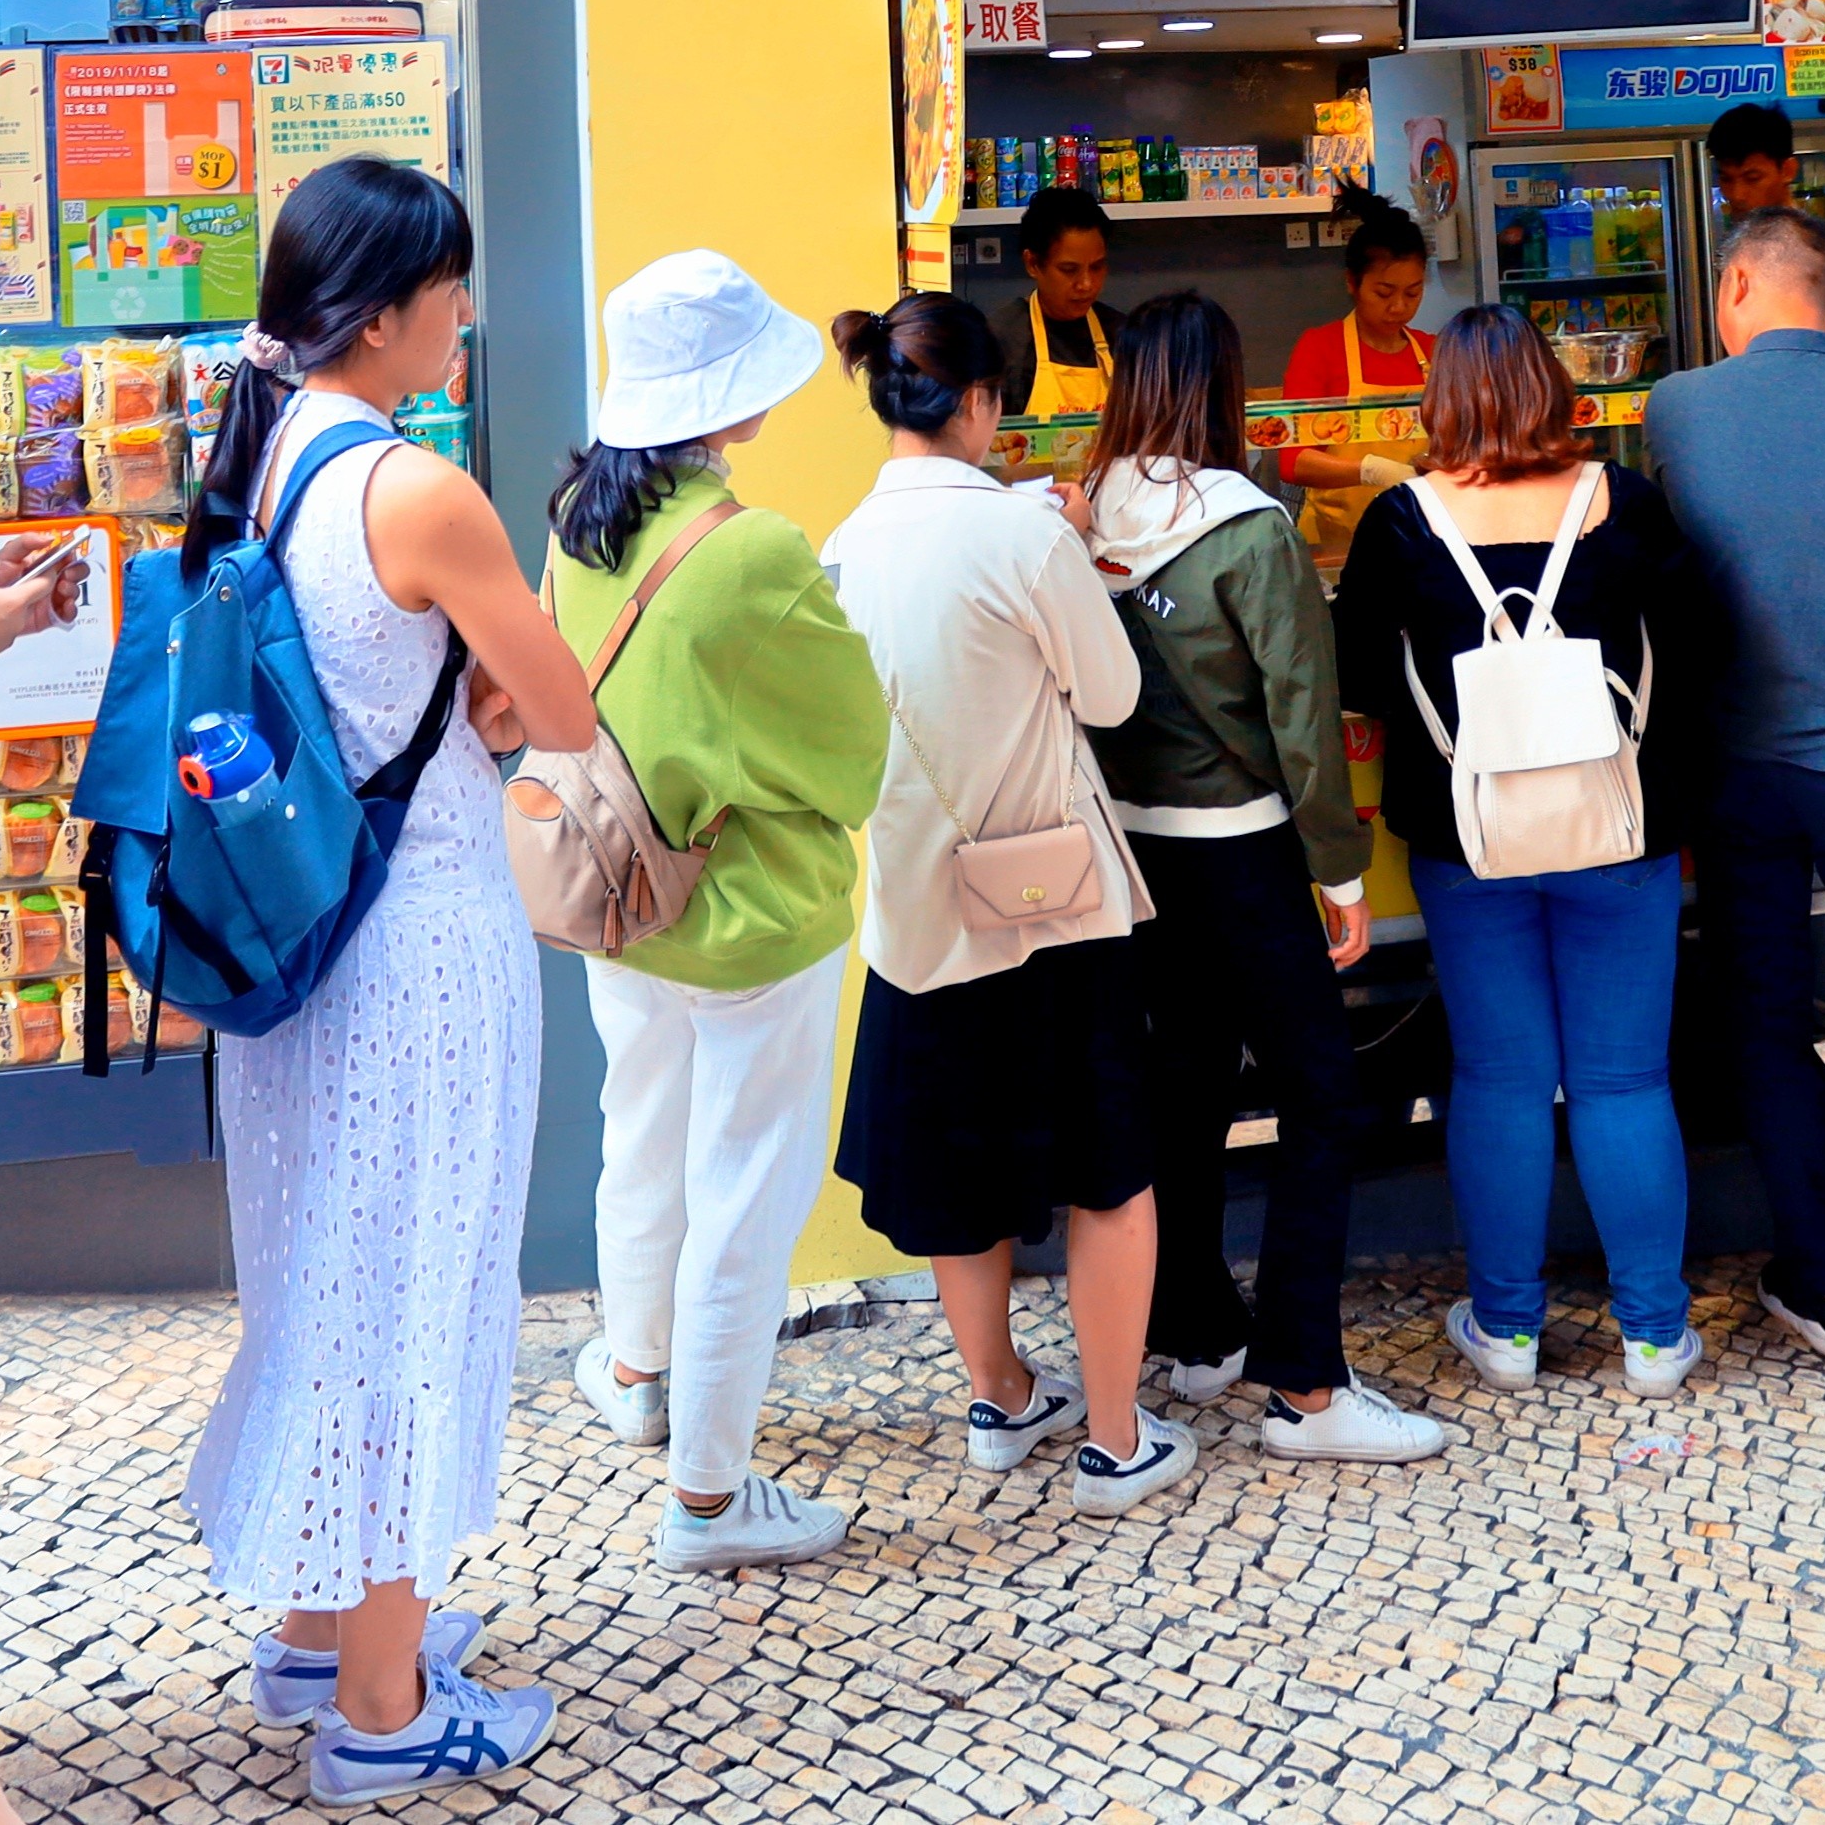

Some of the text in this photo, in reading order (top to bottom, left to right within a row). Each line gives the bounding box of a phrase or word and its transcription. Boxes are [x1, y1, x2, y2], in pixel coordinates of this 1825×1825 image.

[980, 0, 1042, 42] 取餐
[313, 51, 398, 74] 限量優惠
[1508, 57, 1537, 73] $38
[1607, 69, 1667, 99] 东骏
[200, 151, 226, 162] MOP
[198, 161, 222, 180] $1
